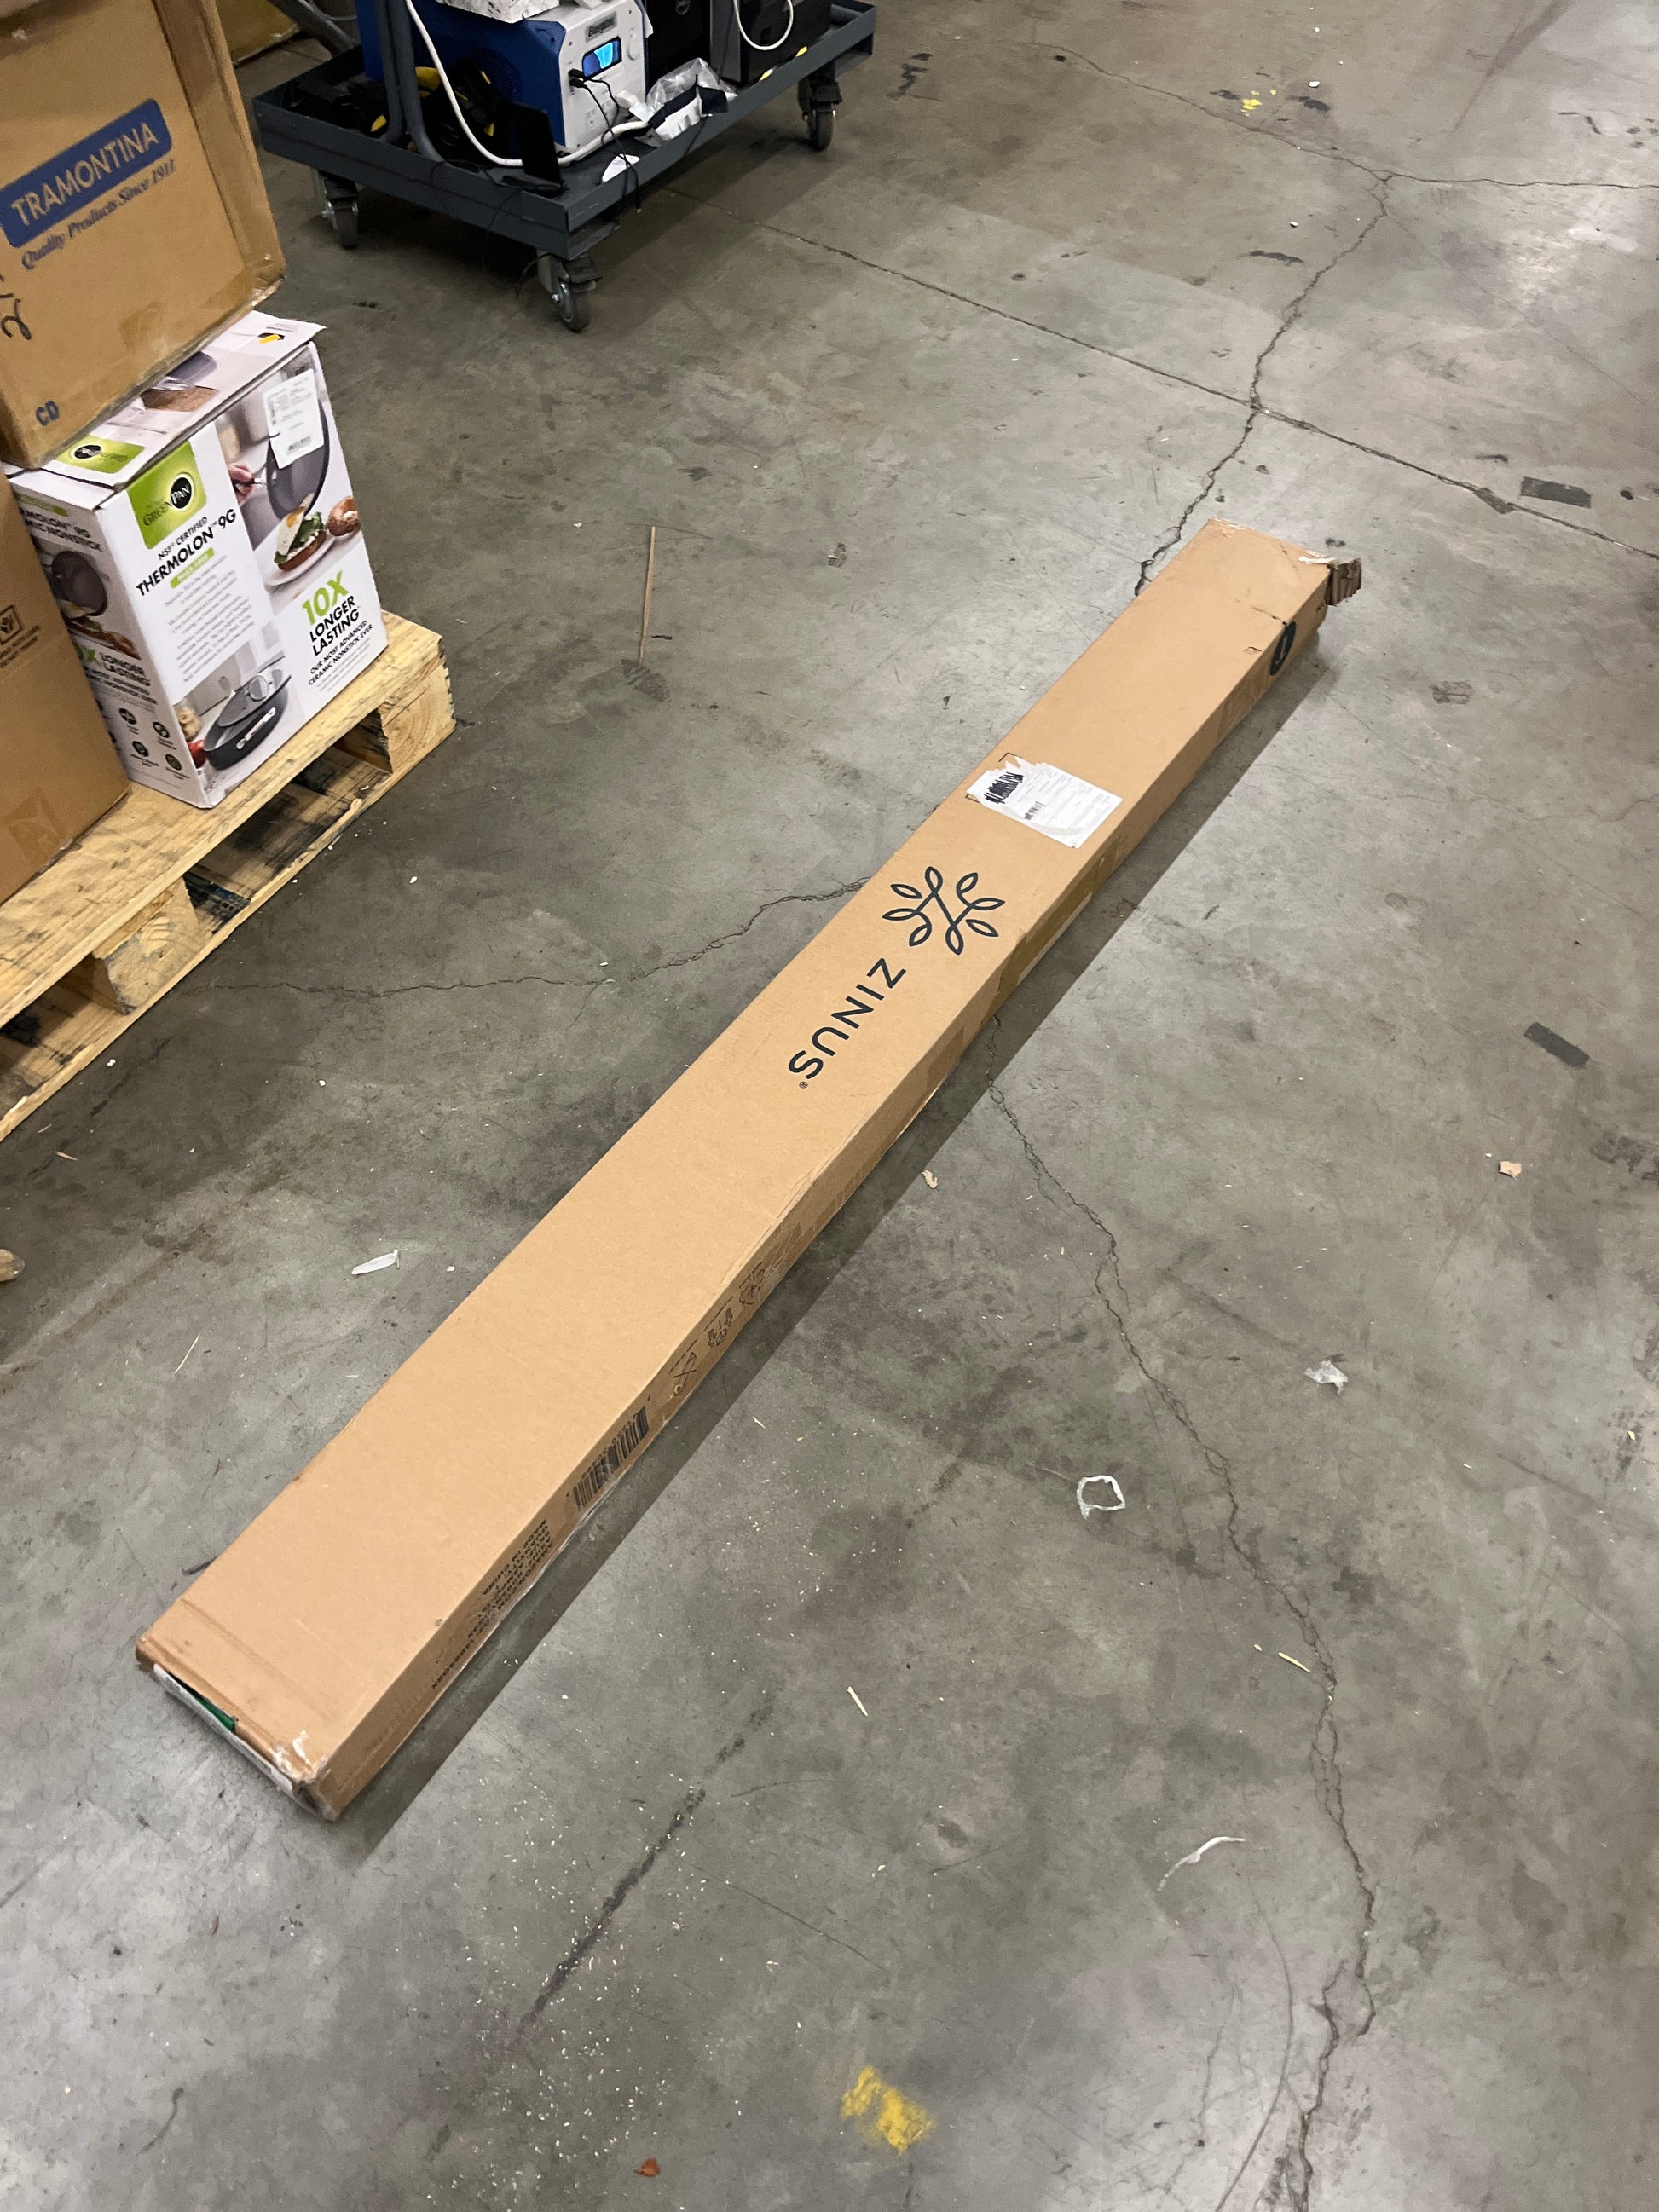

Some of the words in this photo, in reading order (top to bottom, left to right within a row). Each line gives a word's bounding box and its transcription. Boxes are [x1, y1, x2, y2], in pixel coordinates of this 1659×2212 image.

[10, 122, 159, 226] TRAMONTINA
[67, 199, 118, 239] Products
[118, 178, 150, 206] Since
[36, 401, 61, 426] CD
[302, 569, 350, 625] 10X
[309, 595, 356, 643] LONGER
[312, 609, 360, 656] LASTING
[310, 660, 323, 674] OUR
